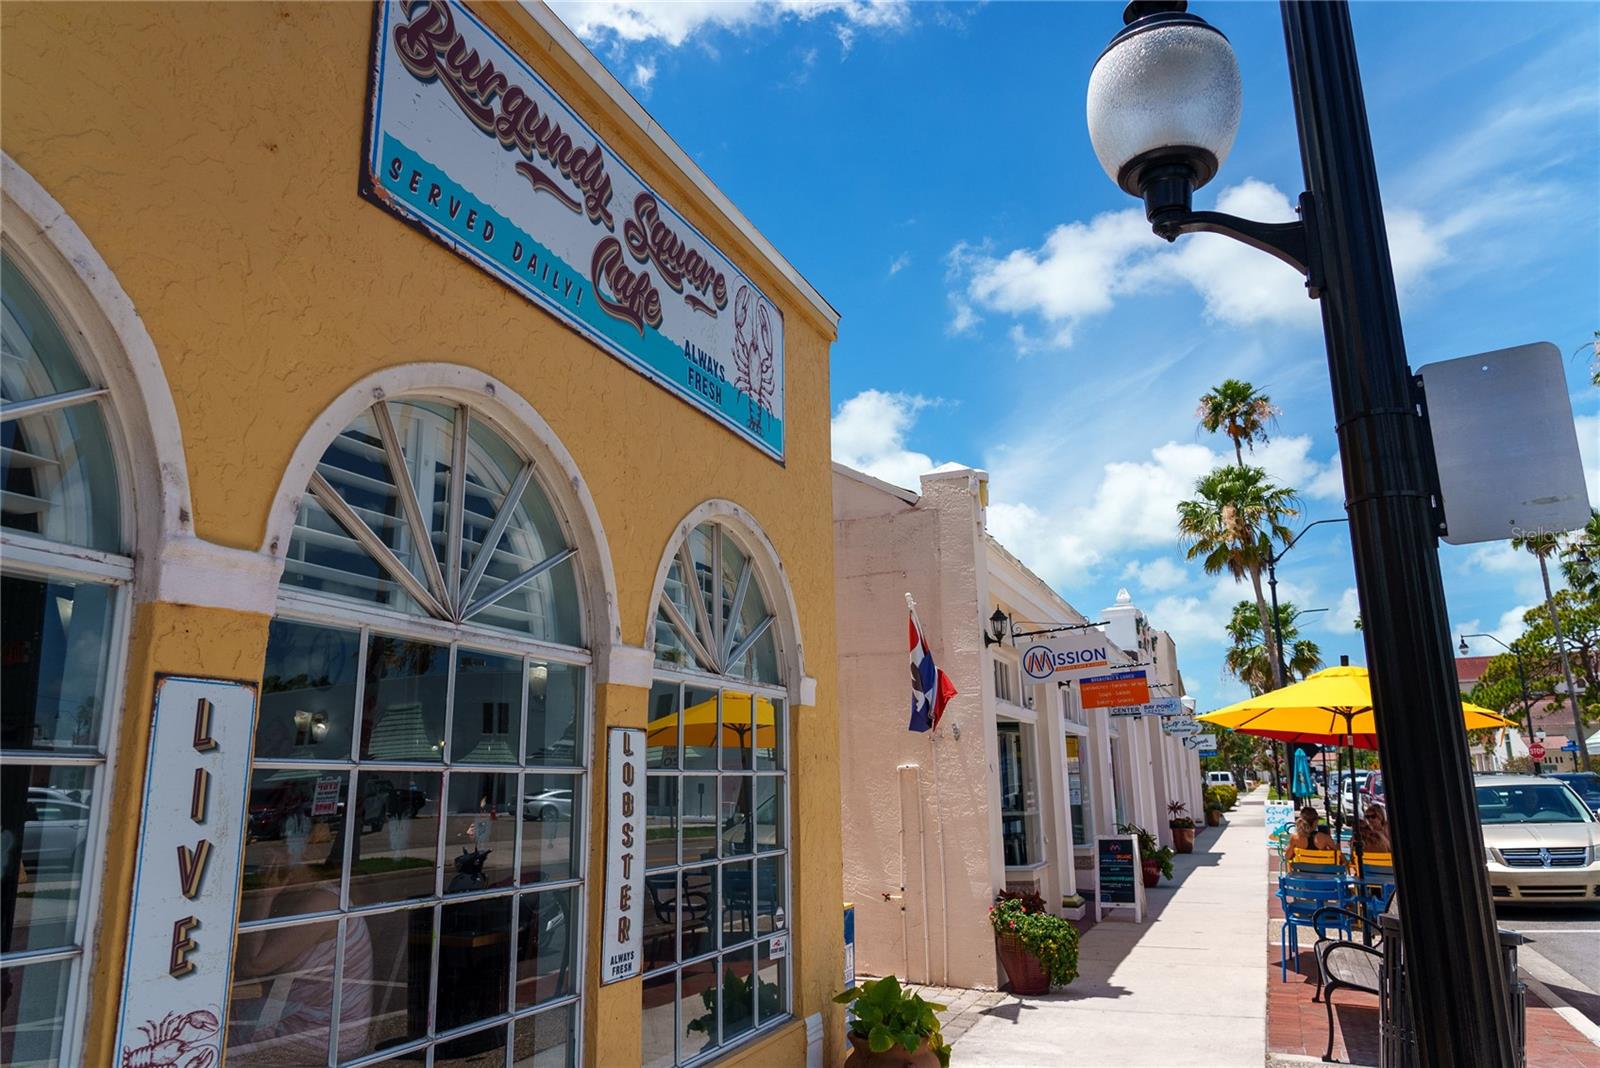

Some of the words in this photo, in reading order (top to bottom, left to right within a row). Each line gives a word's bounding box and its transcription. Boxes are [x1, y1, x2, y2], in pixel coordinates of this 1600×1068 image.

[394, 0, 614, 232] Burgundy
[624, 190, 728, 311] Square
[388, 157, 496, 242] SERVED
[512, 241, 584, 307] DAILY!
[591, 236, 662, 335] Cafe
[683, 339, 726, 383] ALWAYS
[687, 366, 723, 406] FRESH
[1024, 646, 1107, 677] MISSION
[168, 698, 218, 980] LIVE
[617, 731, 635, 945] LOBSTER
[609, 950, 635, 966] ALWAYS
[611, 962, 633, 977] FRESH
